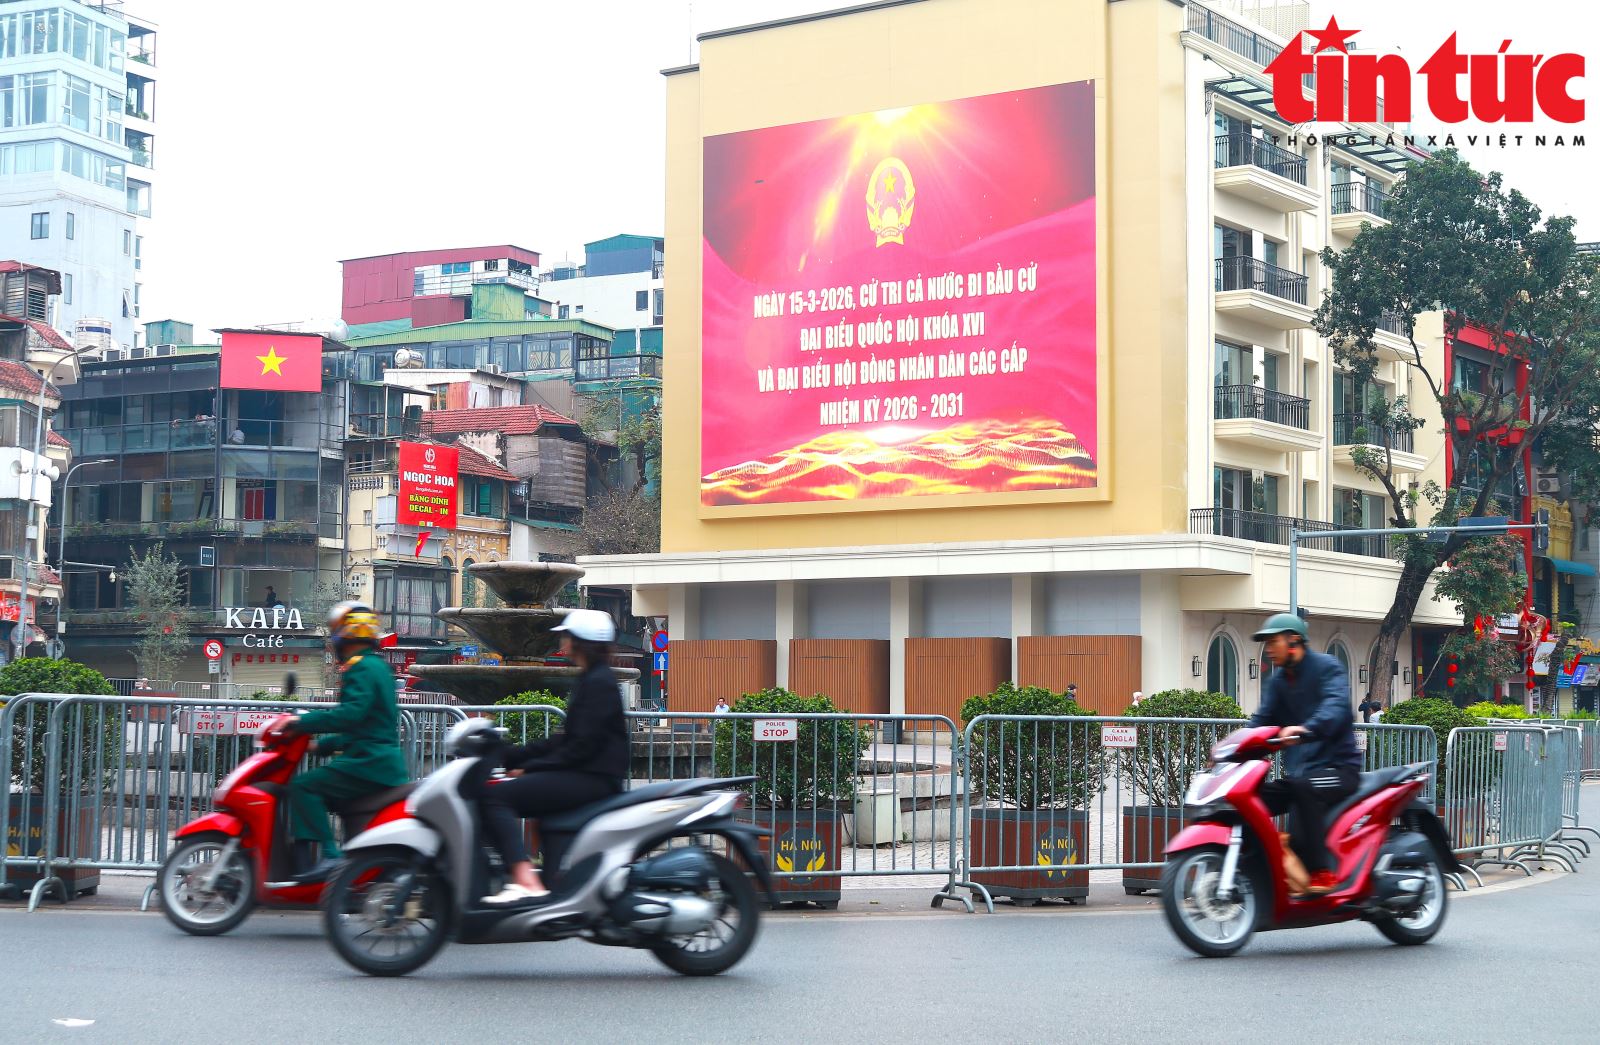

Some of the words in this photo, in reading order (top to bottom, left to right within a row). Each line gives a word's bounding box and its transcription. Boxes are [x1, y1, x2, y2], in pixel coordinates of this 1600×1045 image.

[753, 290, 786, 318] NGÀY
[788, 285, 857, 315] 15-3-2026,
[859, 277, 879, 308] CỬ
[880, 280, 902, 305] TRI
[906, 272, 924, 304] CẢ
[927, 270, 964, 301] NƯỚC
[967, 272, 982, 297] ĐI
[986, 262, 1013, 296] BẦU
[1017, 261, 1038, 293] CỬ
[800, 326, 822, 355] ĐẠI
[825, 316, 854, 349] BIỂU
[857, 313, 893, 348] QUỐC
[896, 314, 919, 346] HỘI
[923, 311, 959, 341] KHÓA
[962, 311, 985, 337] XVI
[757, 365, 775, 393] VÀ
[777, 366, 799, 394] ĐẠI
[802, 356, 831, 389] BIỂU
[834, 358, 857, 389] HỘI
[860, 352, 896, 384] ĐỒNG
[899, 351, 935, 382] NHÂN
[938, 349, 965, 378] DÂN
[969, 346, 997, 376] CÁC
[1000, 340, 1028, 374] CẤP
[820, 396, 860, 429] NHIỆM
[863, 394, 881, 424] KỲ
[883, 395, 918, 422] 2026
[930, 392, 963, 418] 2031
[403, 471, 432, 485] NGỌC
[434, 474, 455, 487] HOA
[409, 504, 433, 513] DECAL
[440, 507, 449, 515] IN
[223, 607, 305, 630] KAFA
[243, 633, 284, 648] Café
[762, 729, 789, 737] STOP
